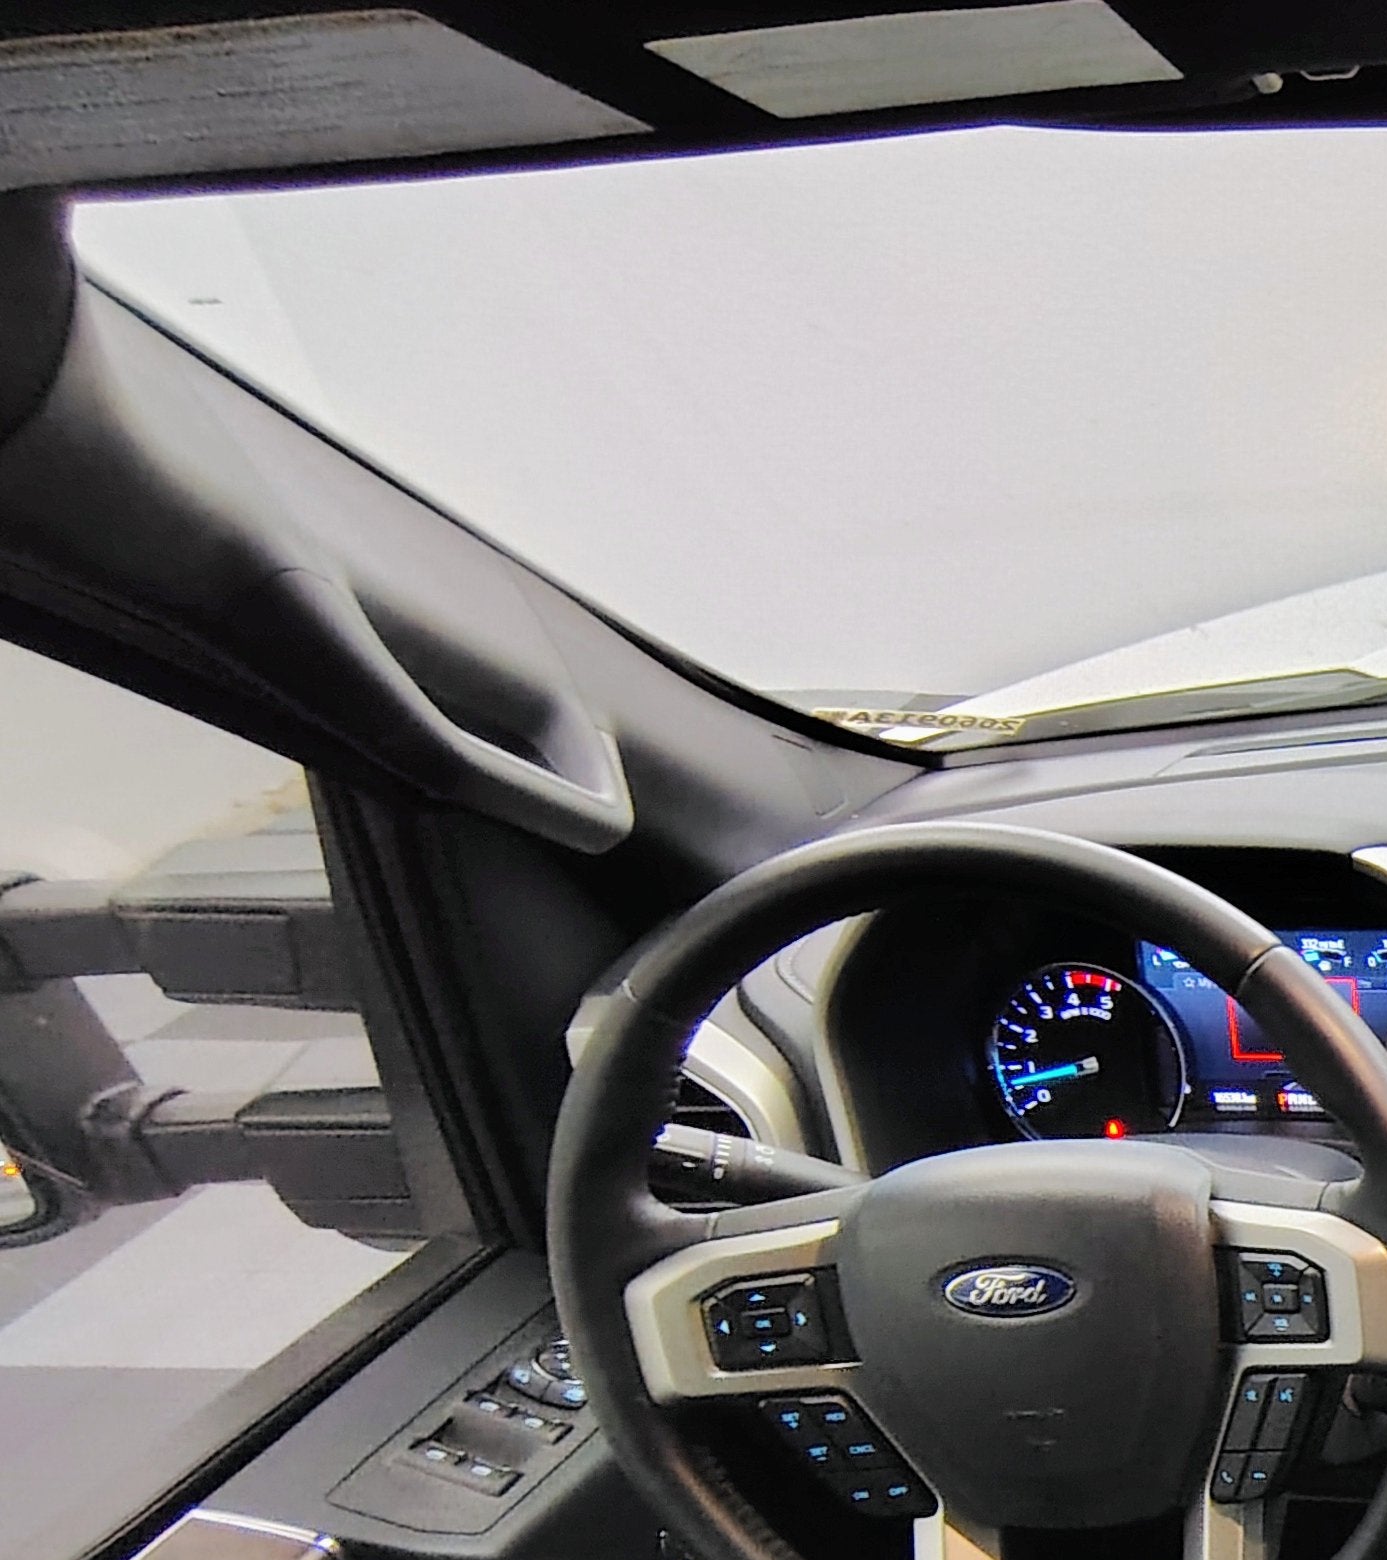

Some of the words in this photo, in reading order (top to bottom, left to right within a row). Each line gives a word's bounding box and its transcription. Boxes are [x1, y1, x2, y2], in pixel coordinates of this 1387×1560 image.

[1066, 992, 1081, 1007] 4
[1099, 994, 1115, 1010] 5
[1039, 1005, 1054, 1020] 3
[1023, 1028, 1040, 1043] 2
[1036, 1089, 1052, 1103] 0
[968, 1271, 1048, 1306] Ford
